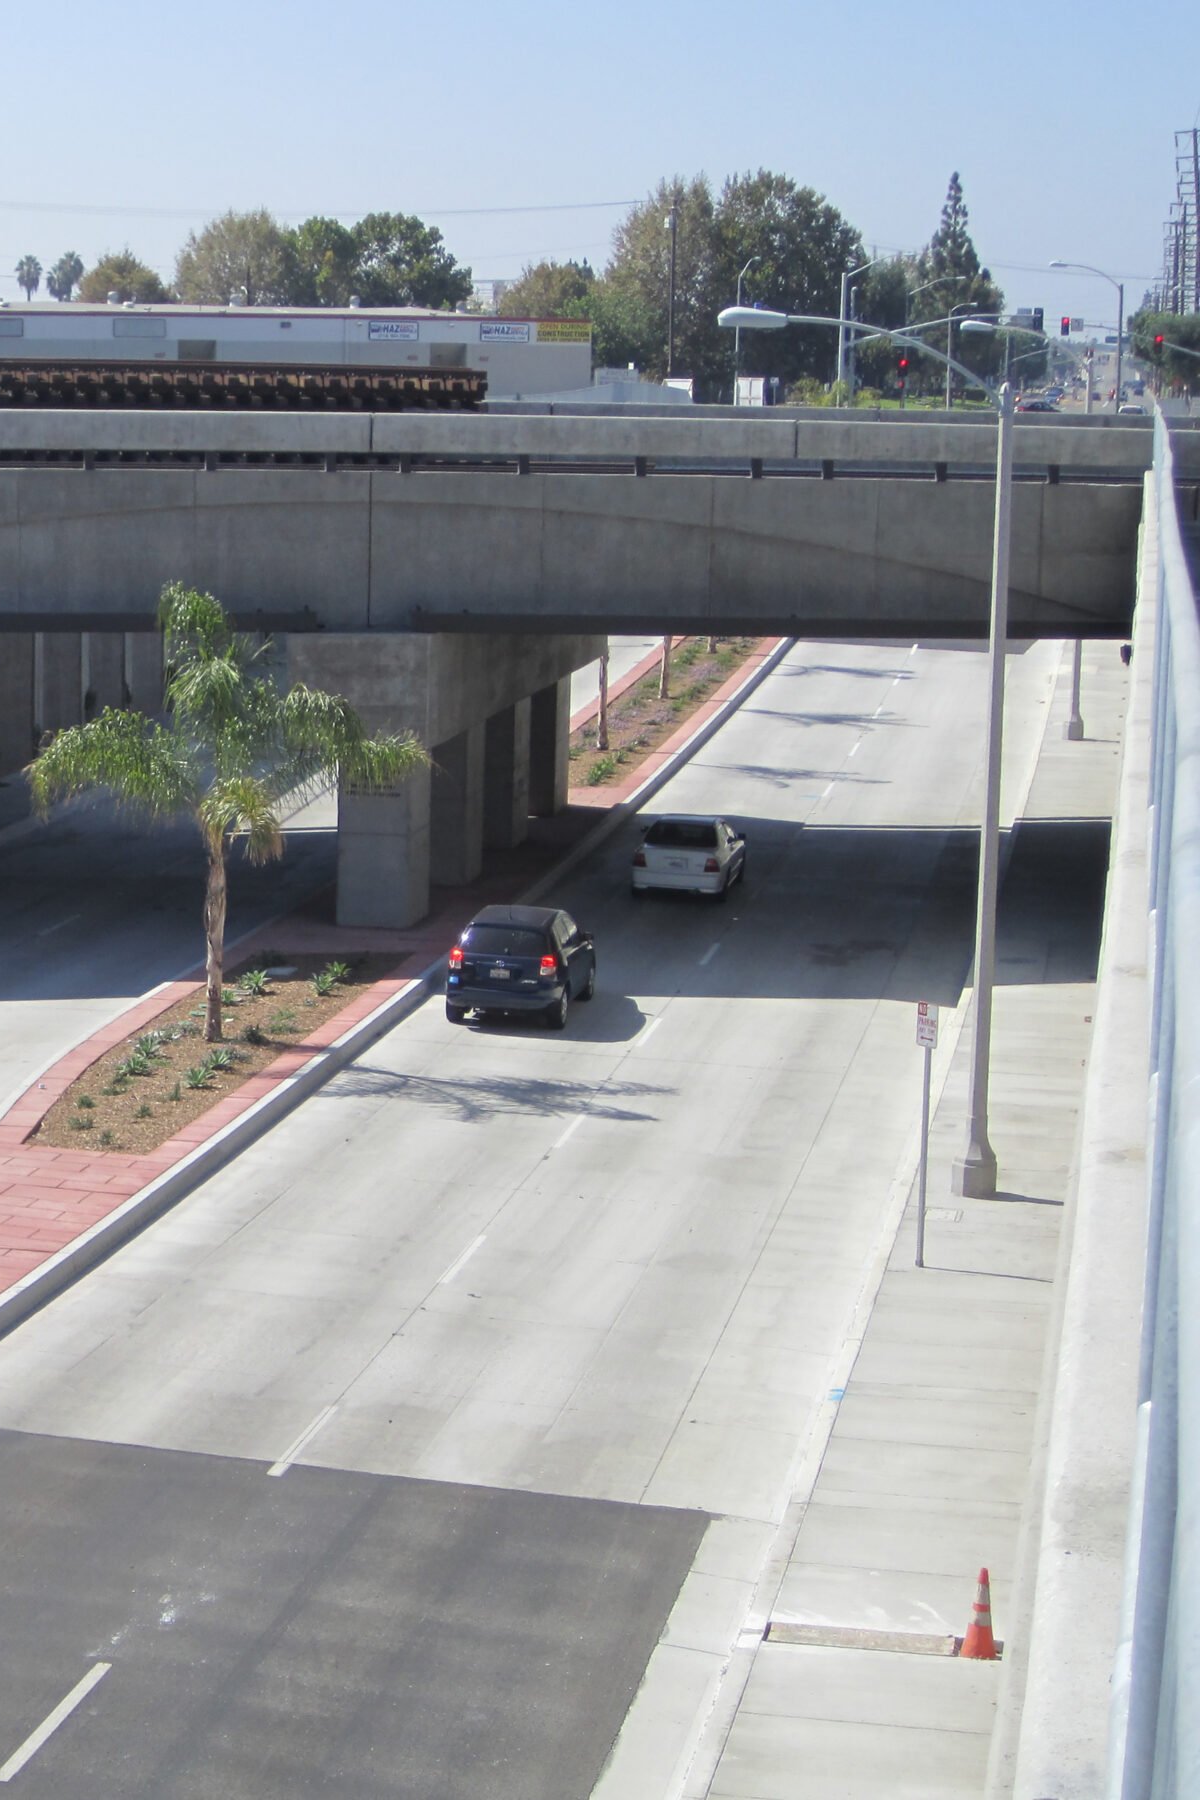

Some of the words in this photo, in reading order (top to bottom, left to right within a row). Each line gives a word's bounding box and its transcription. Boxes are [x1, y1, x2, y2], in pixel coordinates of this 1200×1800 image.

[383, 324, 400, 333] HAZ
[495, 327, 511, 335] HAZ
[537, 330, 590, 338] CONSTRUCTION
[918, 1016, 937, 1028] PARKING
